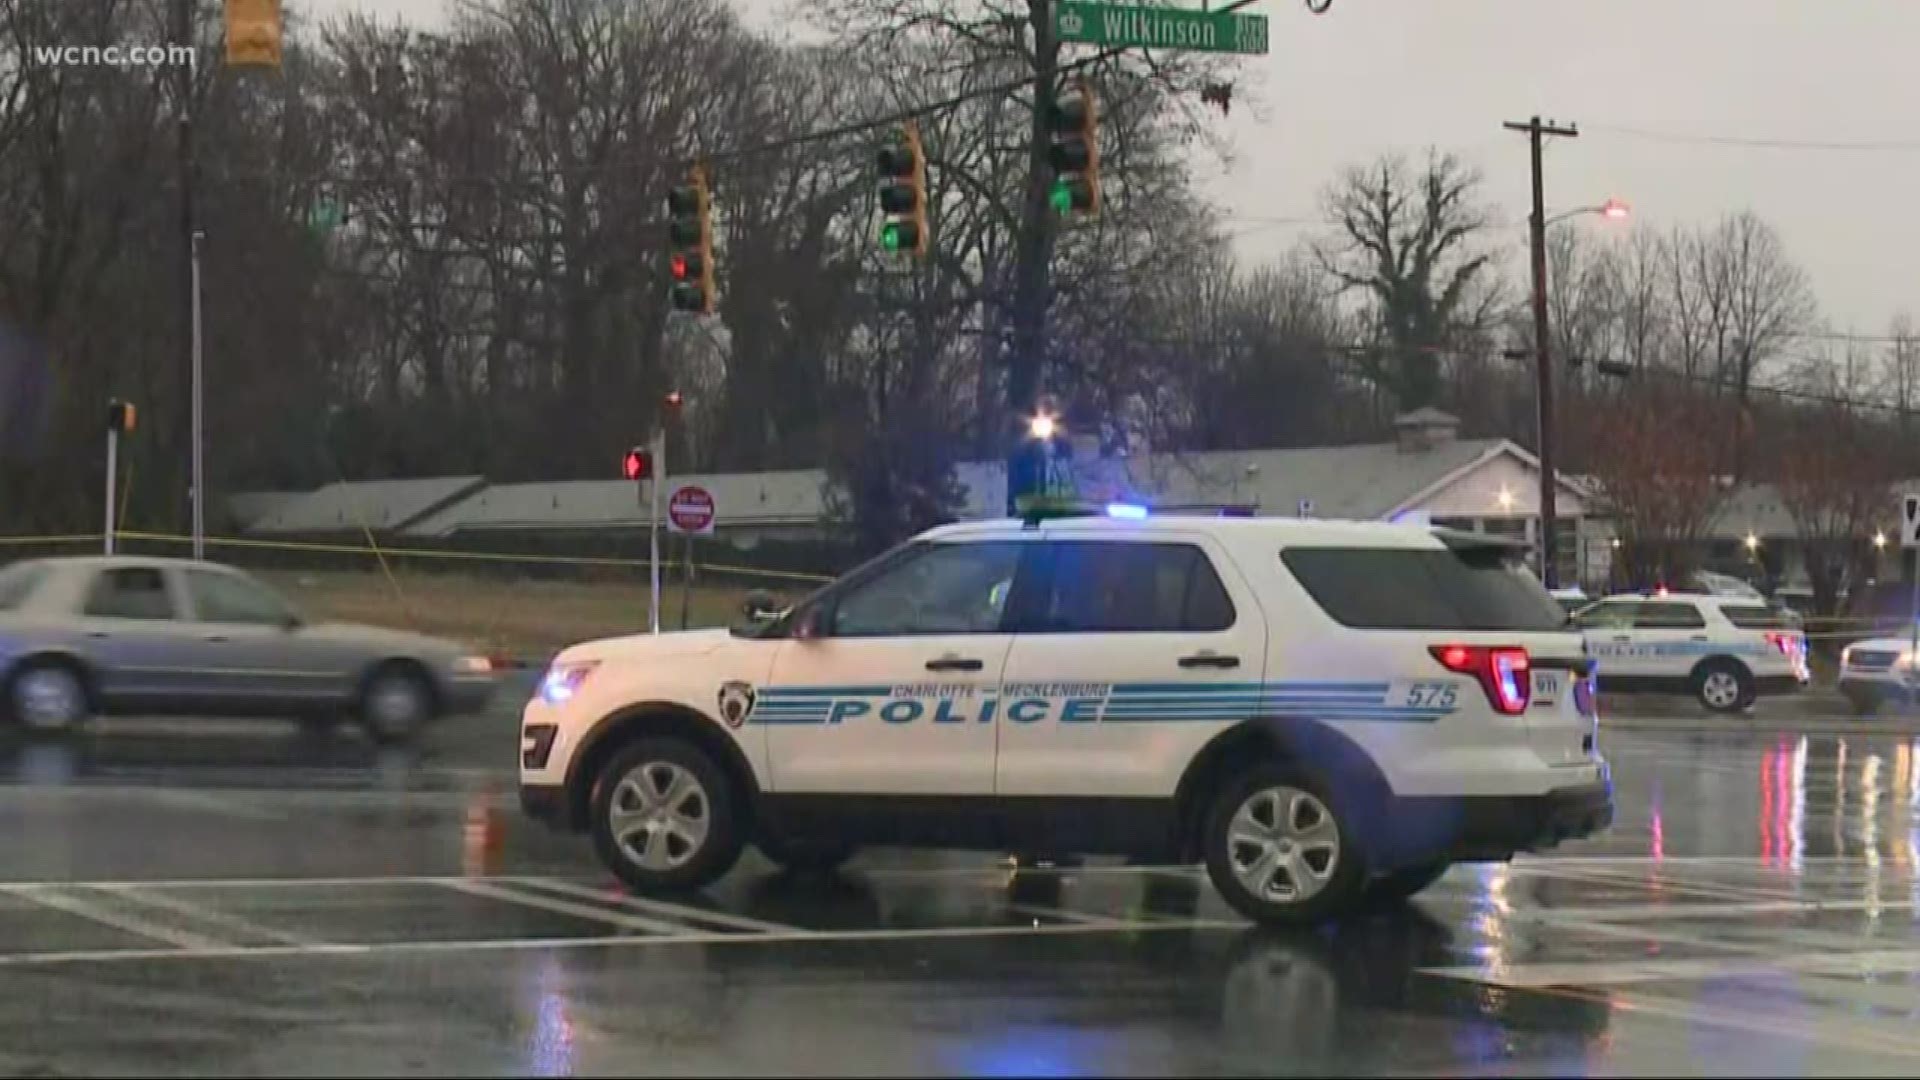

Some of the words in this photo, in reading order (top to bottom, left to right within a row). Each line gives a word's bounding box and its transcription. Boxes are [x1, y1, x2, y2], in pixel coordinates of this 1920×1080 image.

[1103, 7, 1215, 47] Wilkinson
[893, 684, 976, 697] CHARLOTTE
[1003, 683, 1109, 697] MECKLENBURG
[1407, 683, 1459, 706] 575
[829, 699, 1101, 723] POLICE
